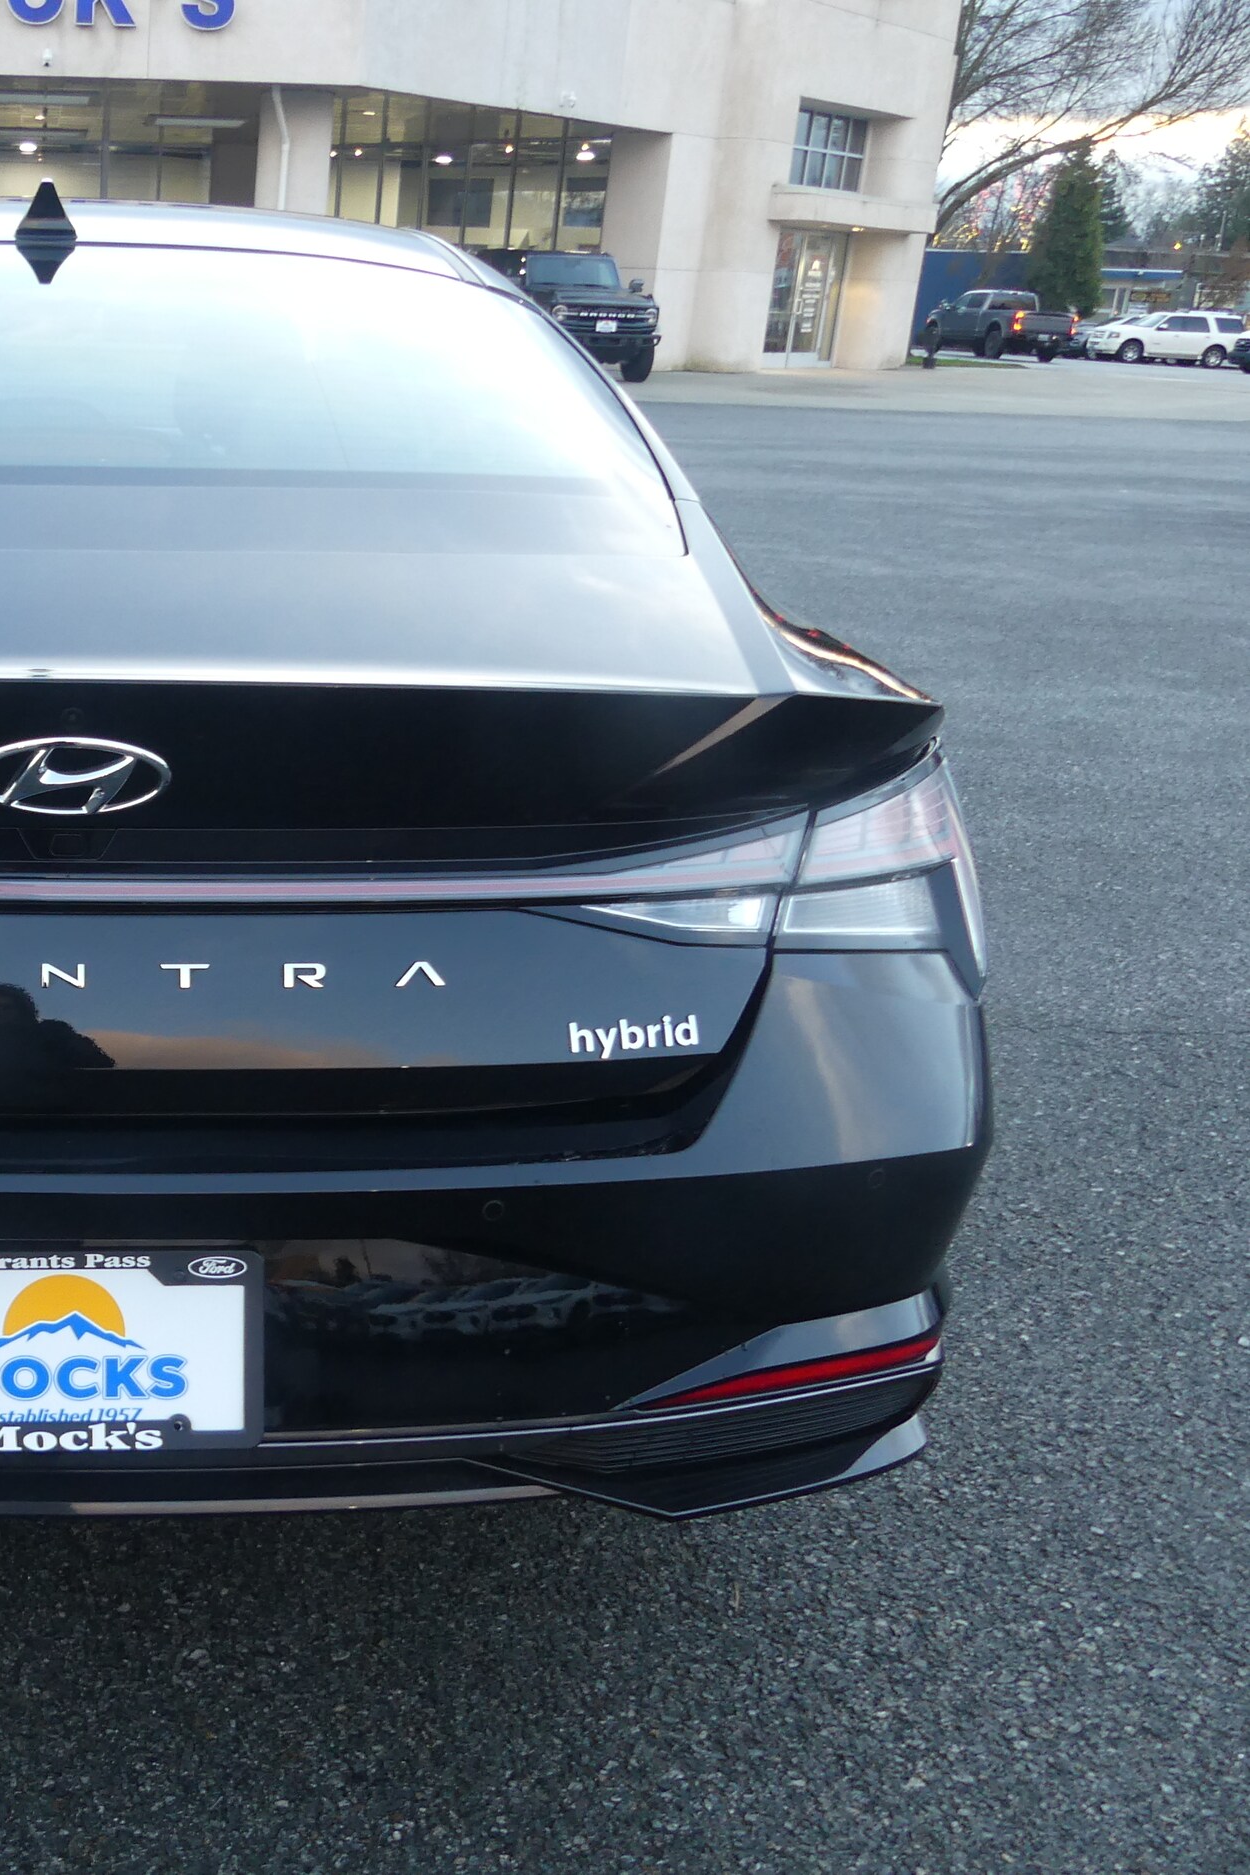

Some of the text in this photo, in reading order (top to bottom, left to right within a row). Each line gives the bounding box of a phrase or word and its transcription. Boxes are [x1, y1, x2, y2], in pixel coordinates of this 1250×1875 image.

[568, 1014, 700, 1060] hybrid
[84, 1253, 151, 1269] Pass
[198, 1259, 237, 1274] Ford
[97, 1407, 143, 1422] 1957
